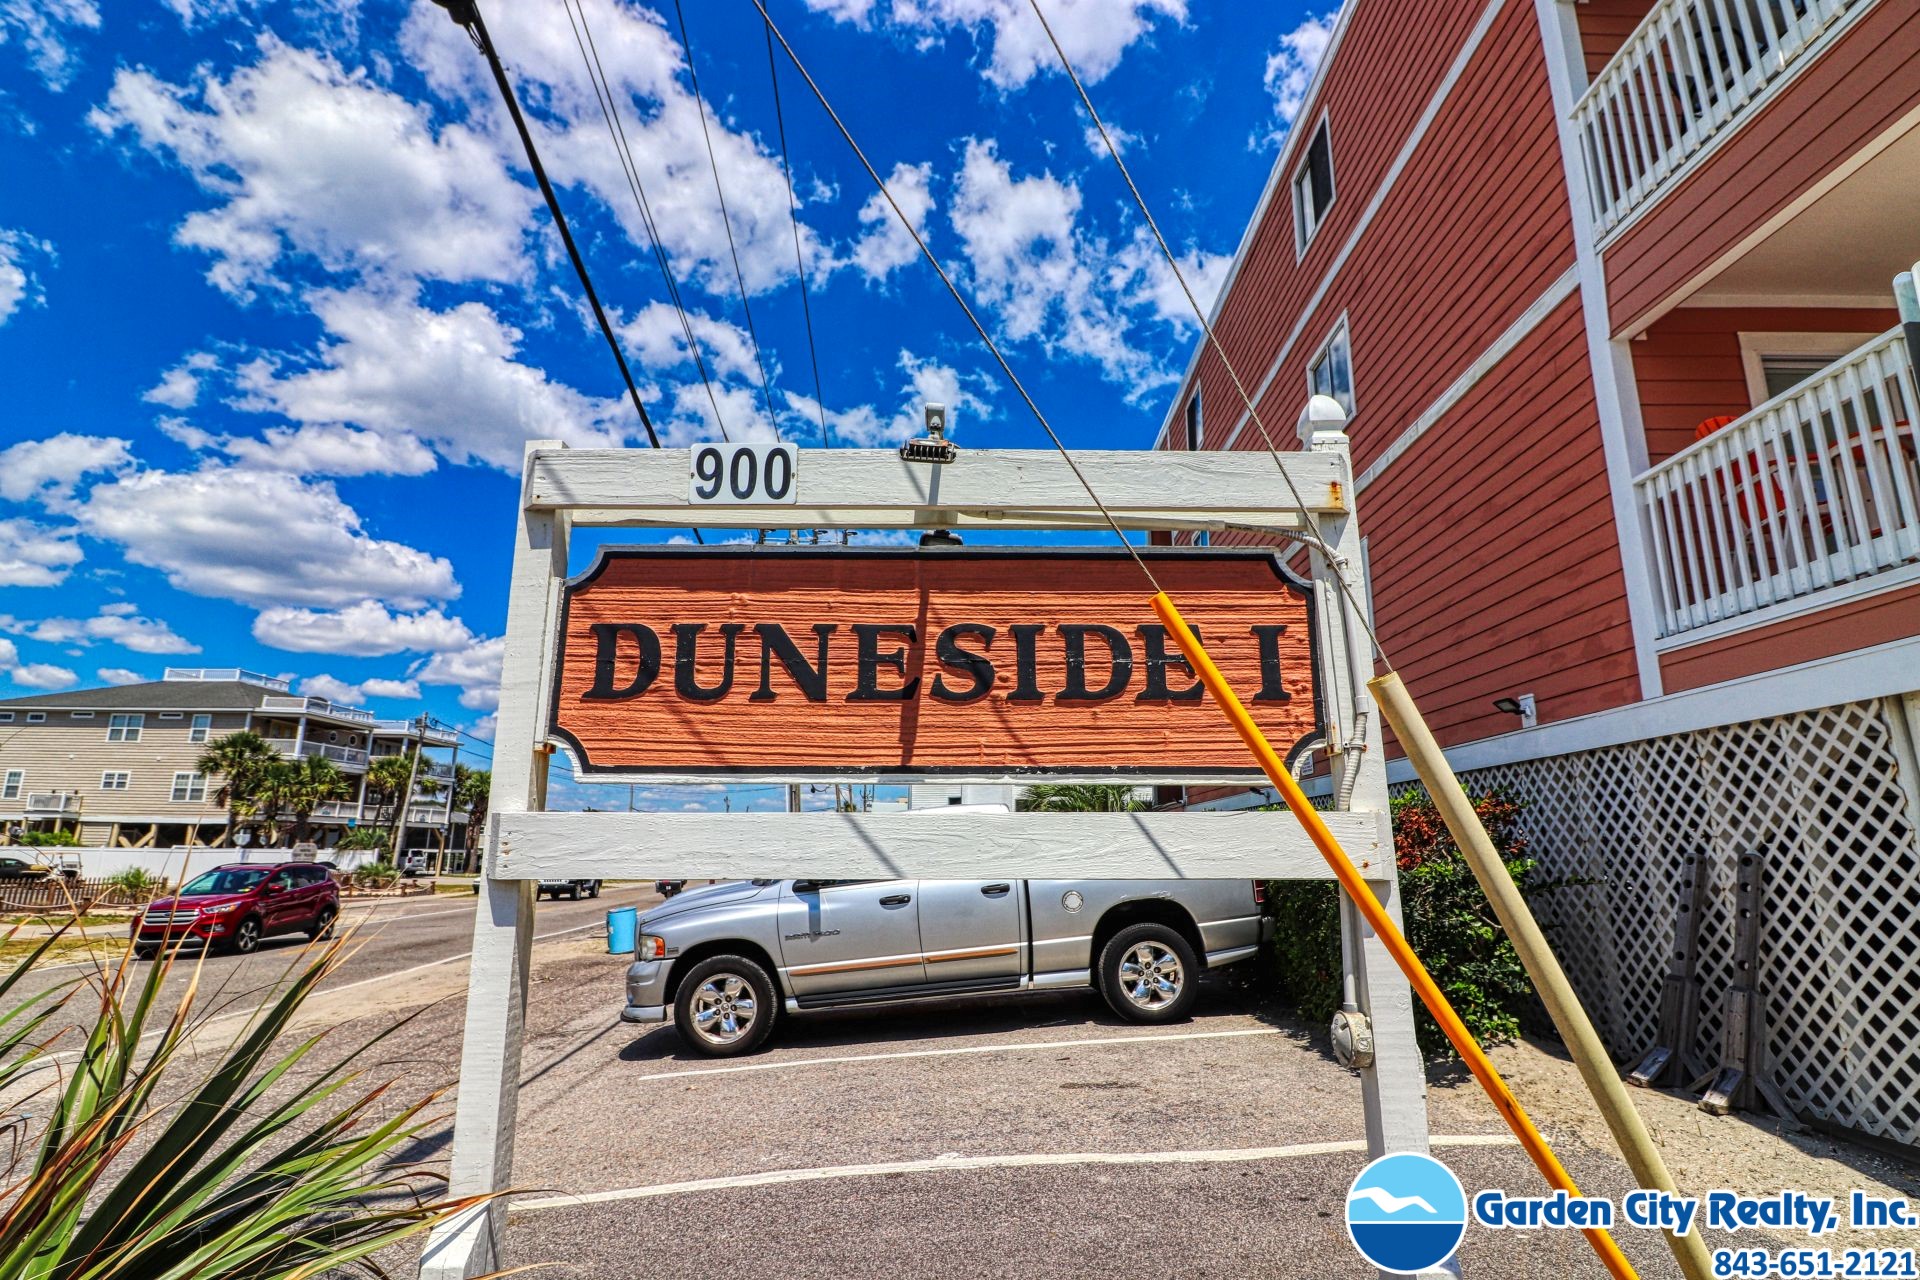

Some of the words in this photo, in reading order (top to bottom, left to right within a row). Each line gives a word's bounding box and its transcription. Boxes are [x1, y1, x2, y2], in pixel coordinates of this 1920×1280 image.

[696, 447, 792, 500] 900
[580, 622, 1205, 702] DUNESIDE
[1250, 624, 1292, 702] I
